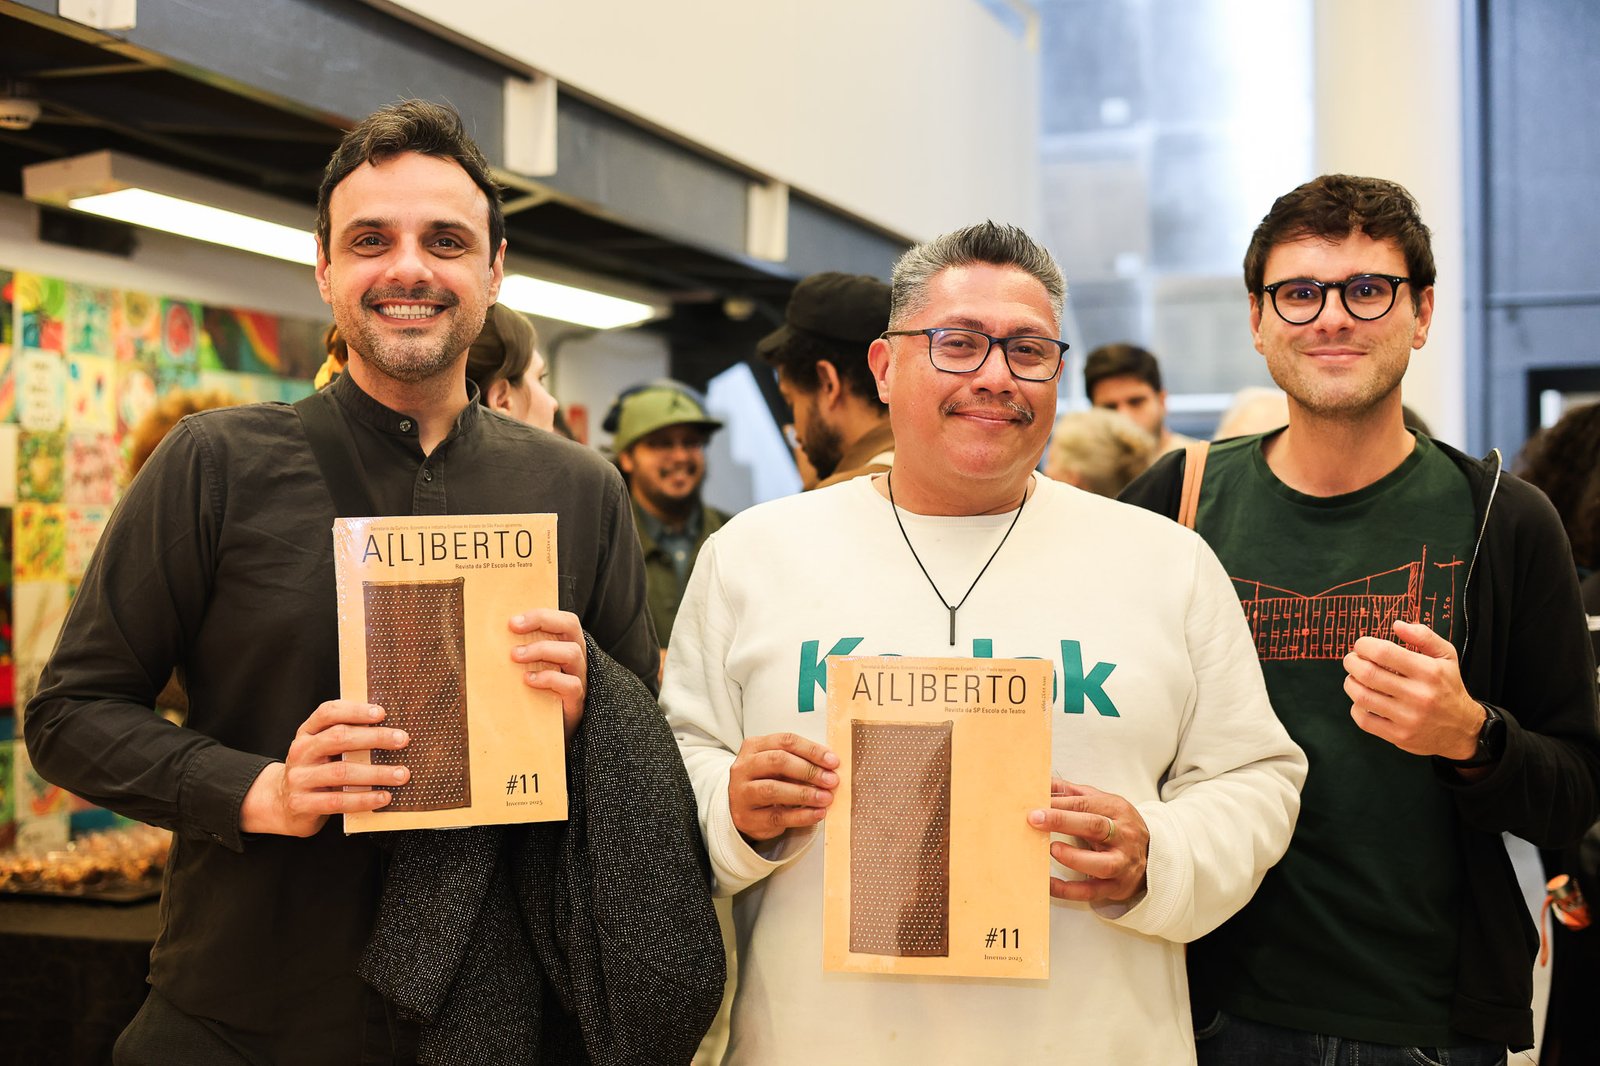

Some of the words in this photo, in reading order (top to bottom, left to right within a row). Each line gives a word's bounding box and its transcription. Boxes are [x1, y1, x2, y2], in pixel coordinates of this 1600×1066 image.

[362, 529, 532, 567] A[L]BERTO
[852, 672, 1026, 706] A[L]BERTO
[506, 773, 538, 795] #11
[985, 928, 1019, 948] #11
